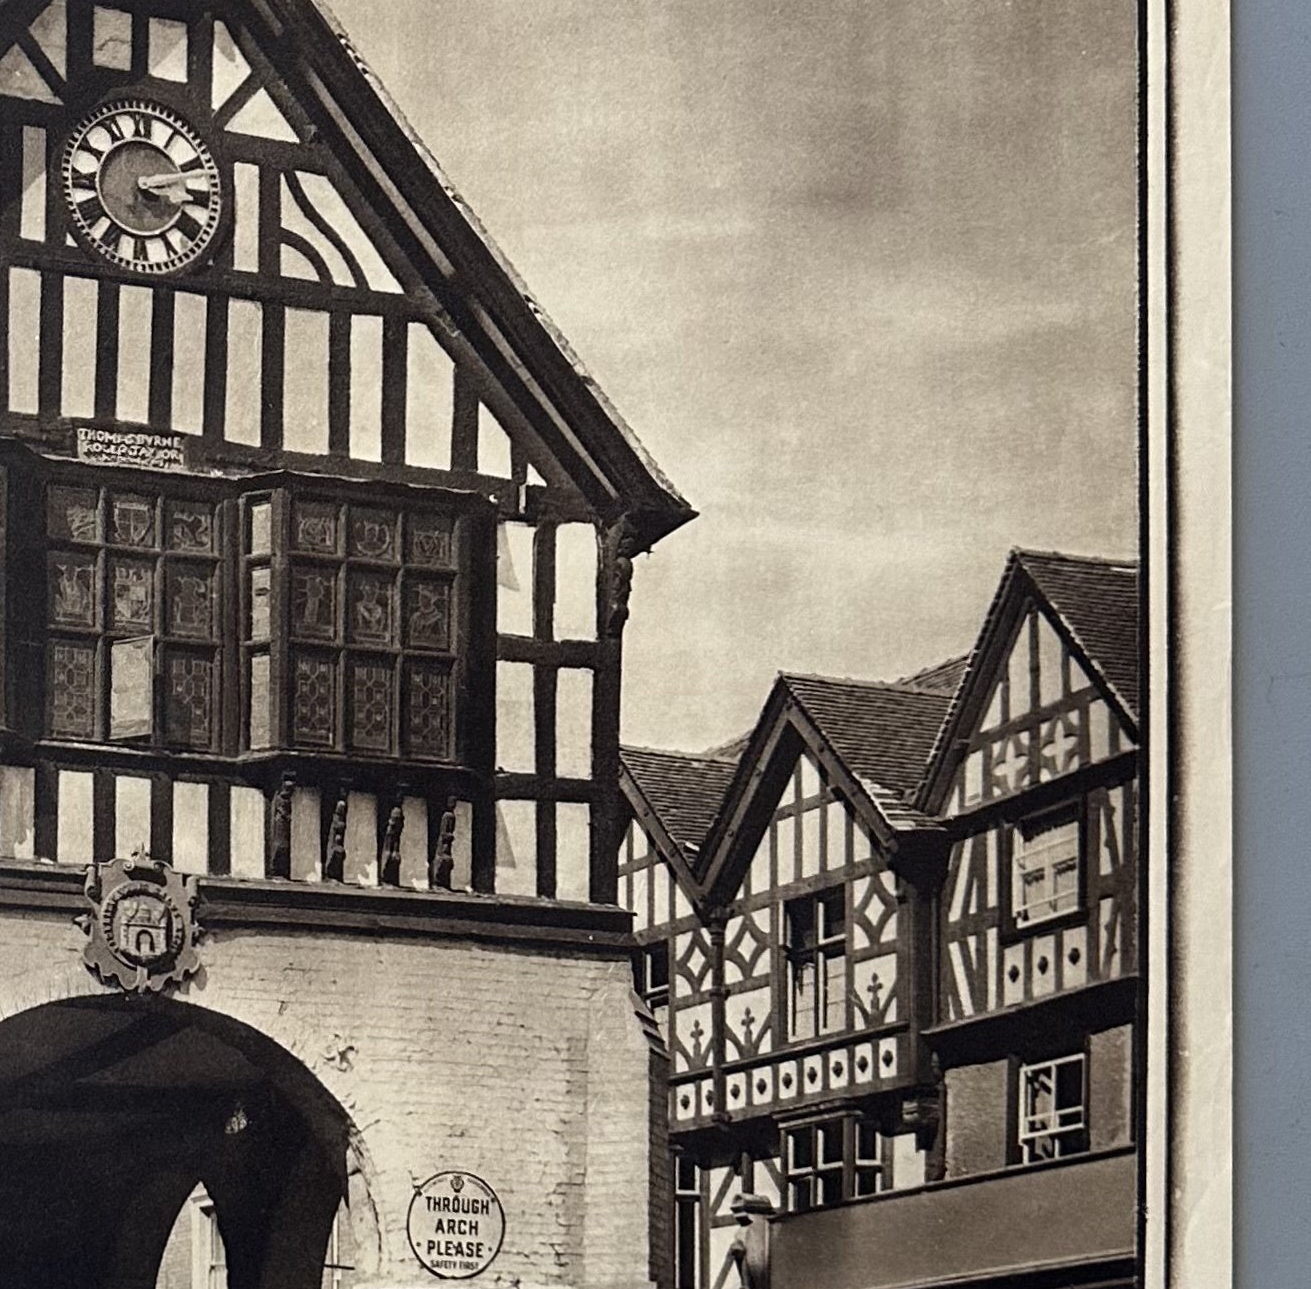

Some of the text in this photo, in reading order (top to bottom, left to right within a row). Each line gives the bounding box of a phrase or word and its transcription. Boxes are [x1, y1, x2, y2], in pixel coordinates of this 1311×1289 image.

[425, 1196, 490, 1215] THROUGH
[435, 1218, 479, 1236] ARCH
[427, 1240, 484, 1258] PLEASE
